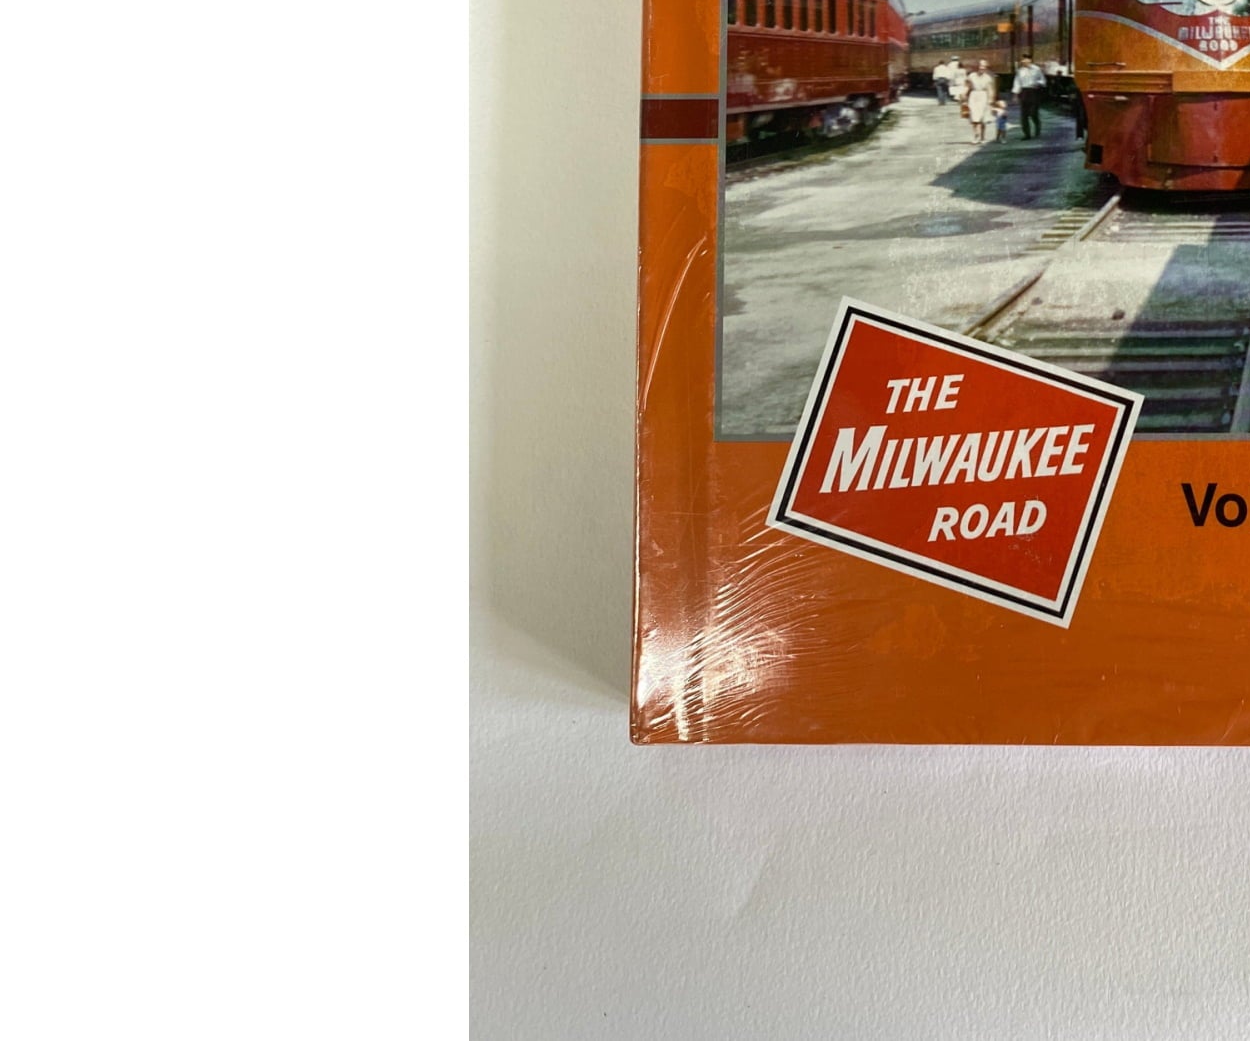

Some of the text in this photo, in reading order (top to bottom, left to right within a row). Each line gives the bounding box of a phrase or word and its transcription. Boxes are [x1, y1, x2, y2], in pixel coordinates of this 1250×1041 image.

[885, 374, 965, 414] THE
[819, 423, 1096, 494] MILWAUKEE
[927, 500, 1048, 543] ROAD
